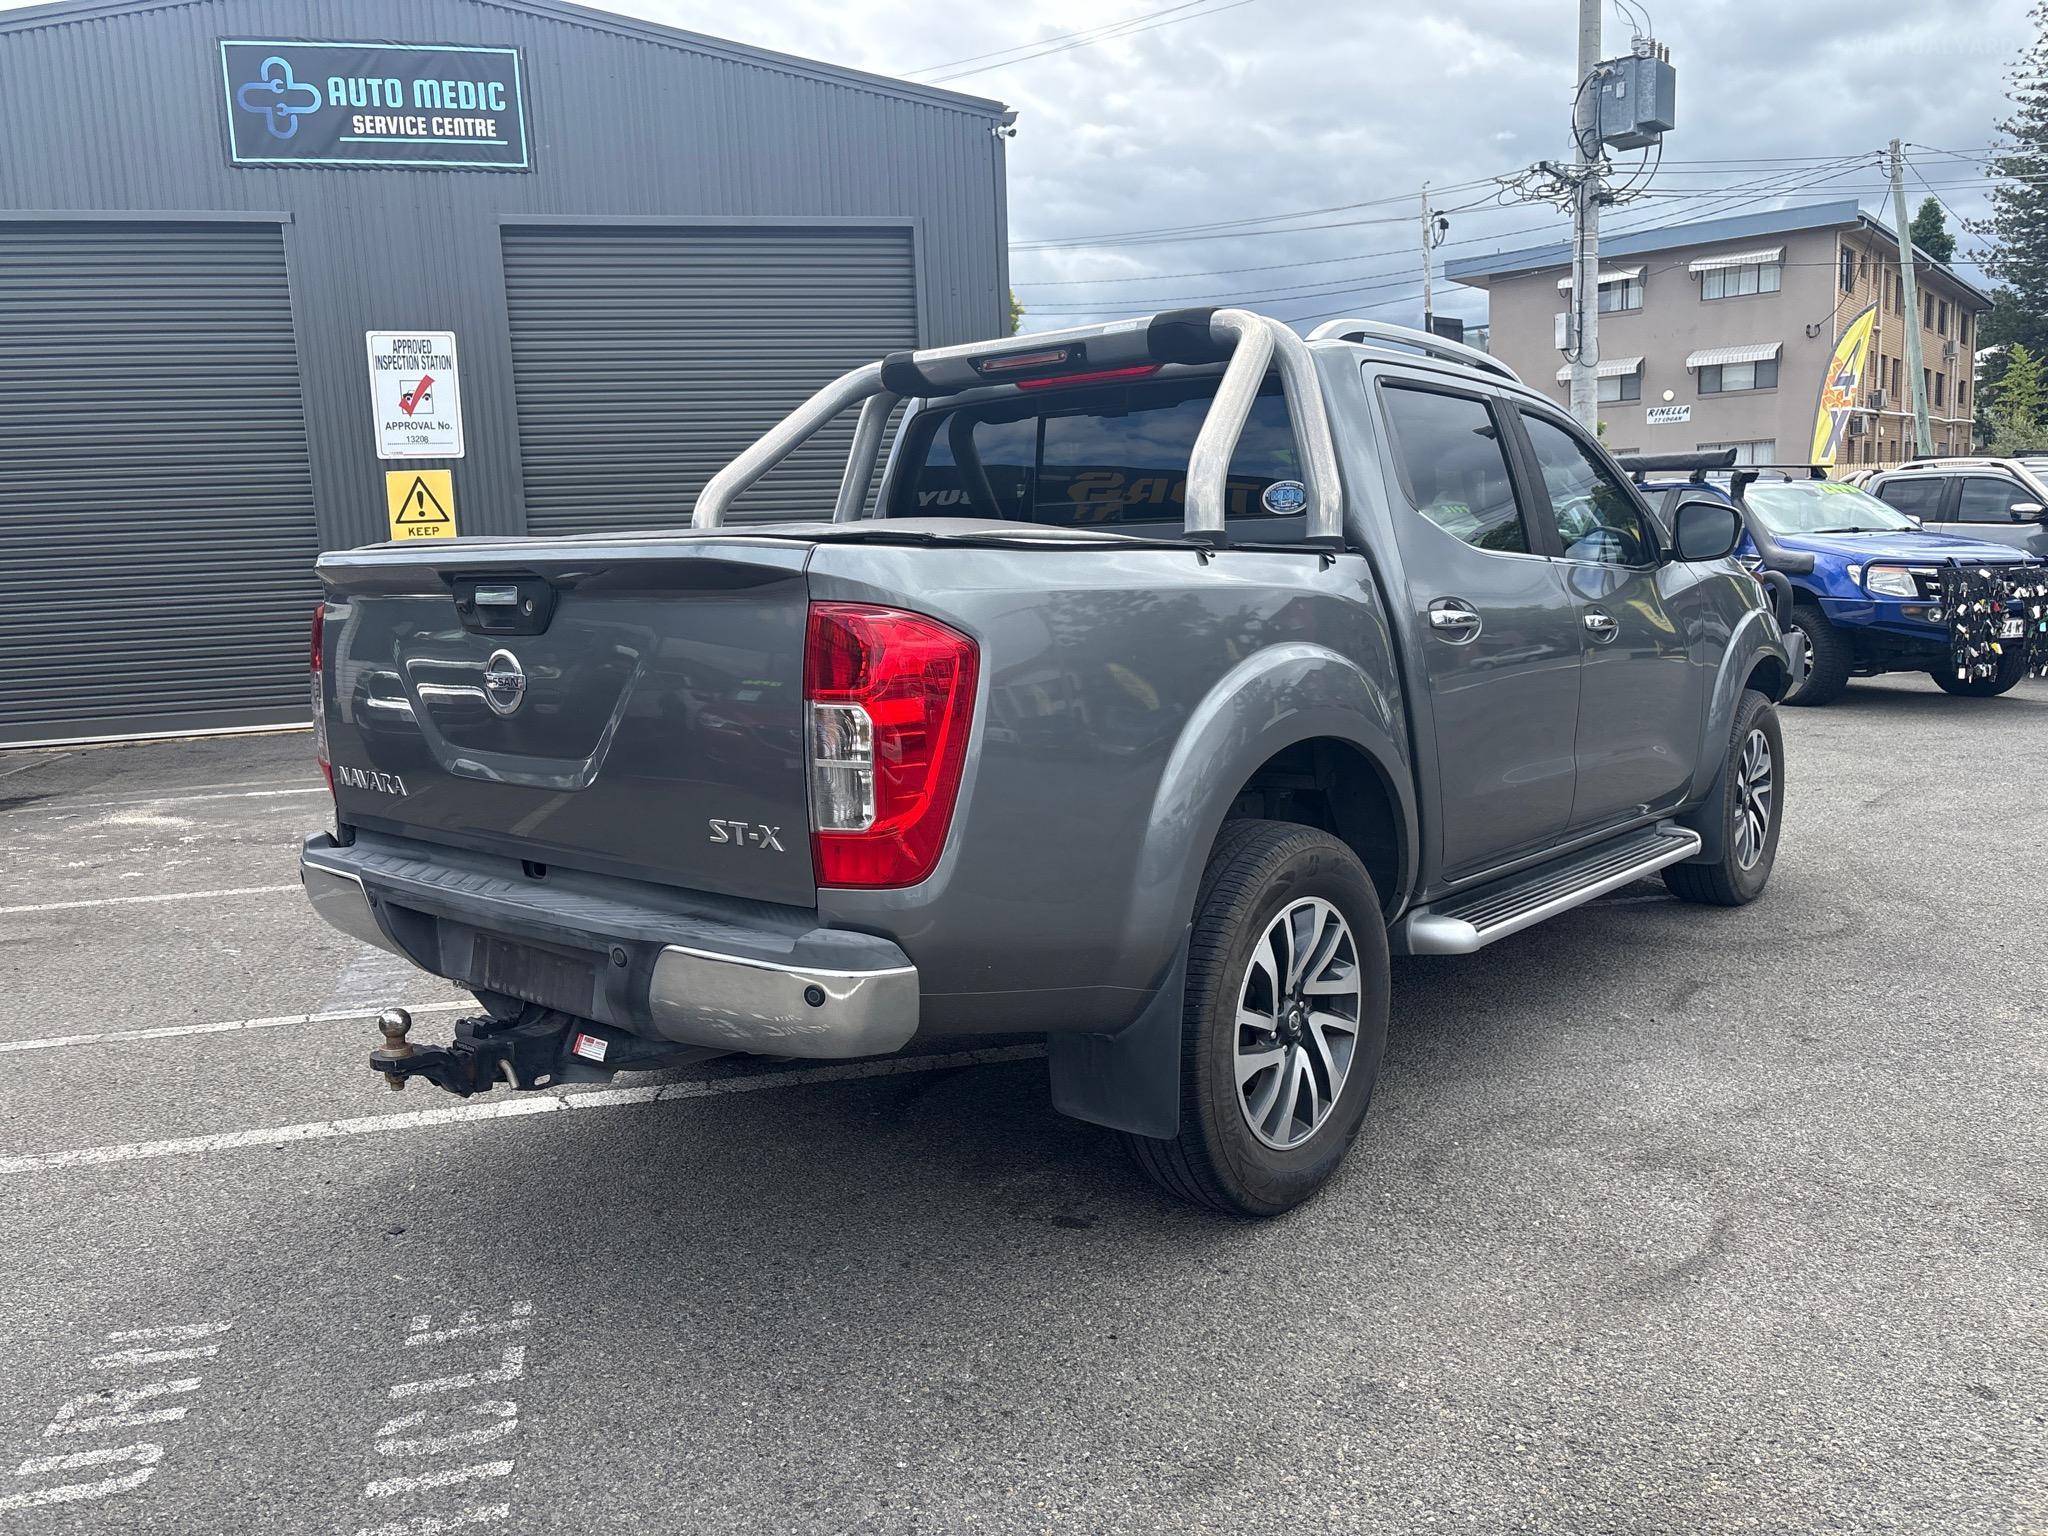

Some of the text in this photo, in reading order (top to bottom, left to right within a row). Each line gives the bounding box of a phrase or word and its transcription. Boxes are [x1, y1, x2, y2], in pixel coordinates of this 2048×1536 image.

[327, 77, 506, 112] AUTO MEDIC
[352, 115, 497, 137] SERVICE CENTRE
[393, 339, 432, 354] APPROVED
[375, 355, 452, 370] INSPECTION STATION
[1648, 406, 1690, 417] RINELLA
[385, 421, 453, 430] APPROVAL No.
[408, 526, 440, 536] KEEP
[486, 675, 519, 687] SSAN
[339, 765, 408, 796] NAVARA
[709, 819, 784, 852] ST-X
